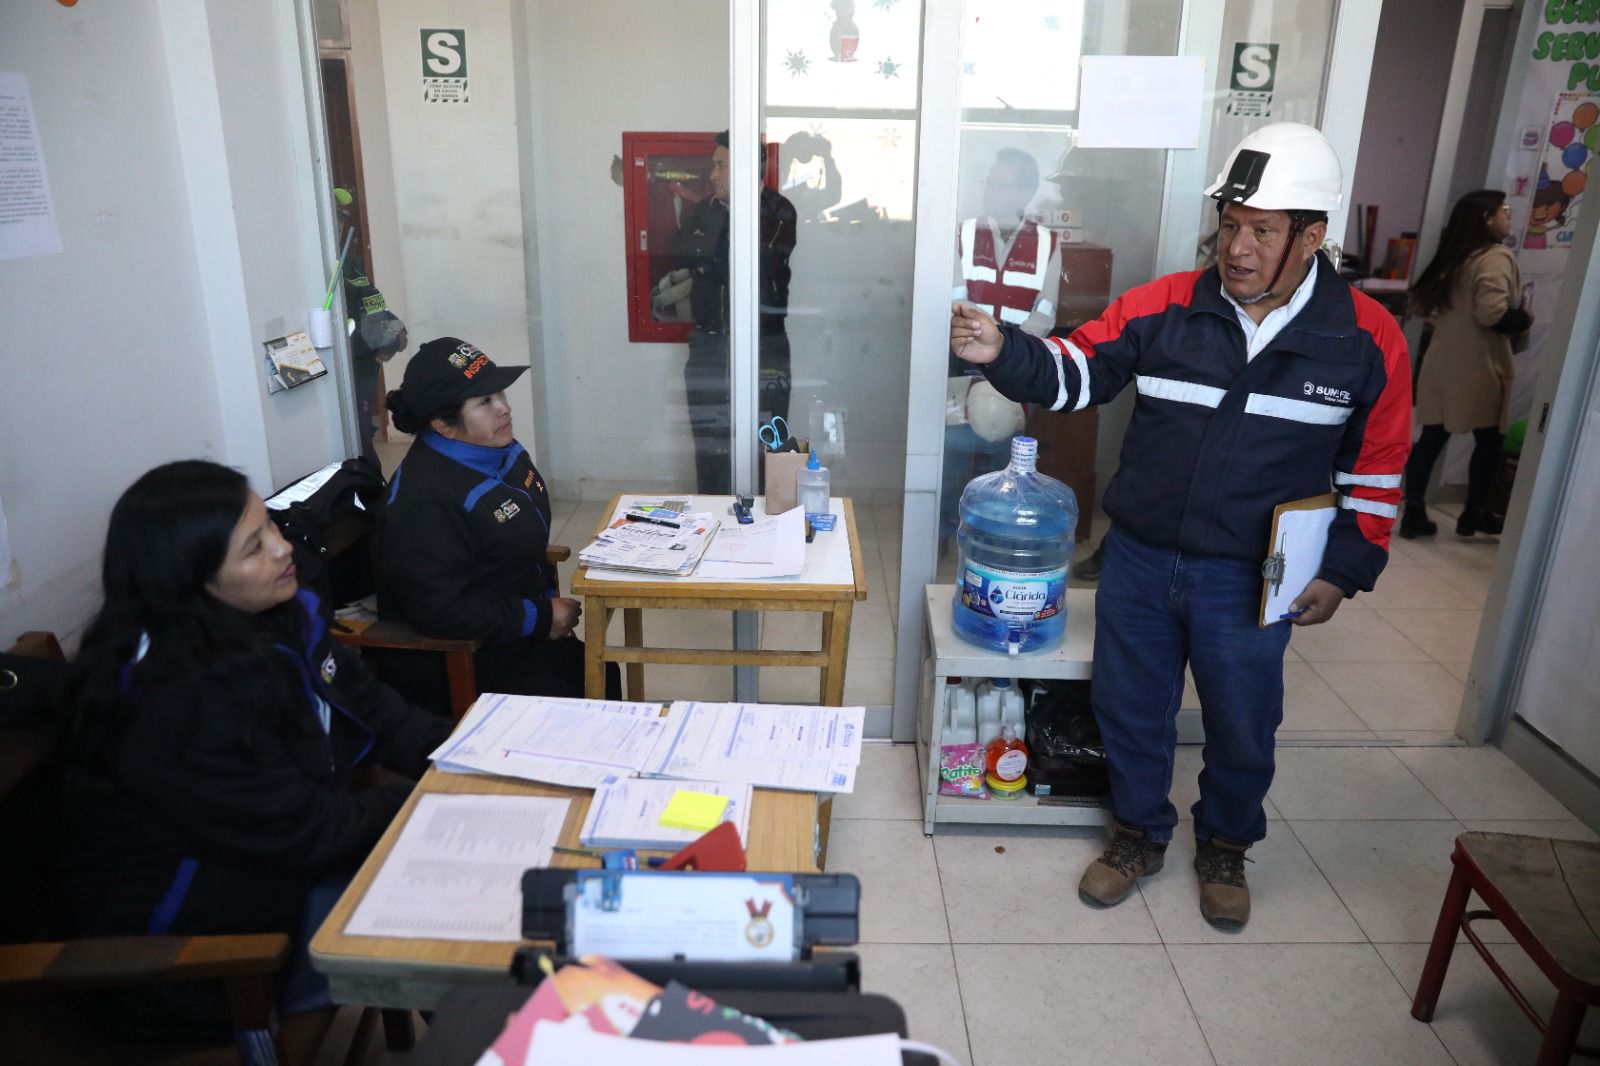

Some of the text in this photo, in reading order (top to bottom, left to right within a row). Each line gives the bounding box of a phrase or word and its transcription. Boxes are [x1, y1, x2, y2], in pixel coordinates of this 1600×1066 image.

[427, 32, 461, 74] S
[1236, 46, 1271, 88] S
[1532, 31, 1600, 62] SERV
